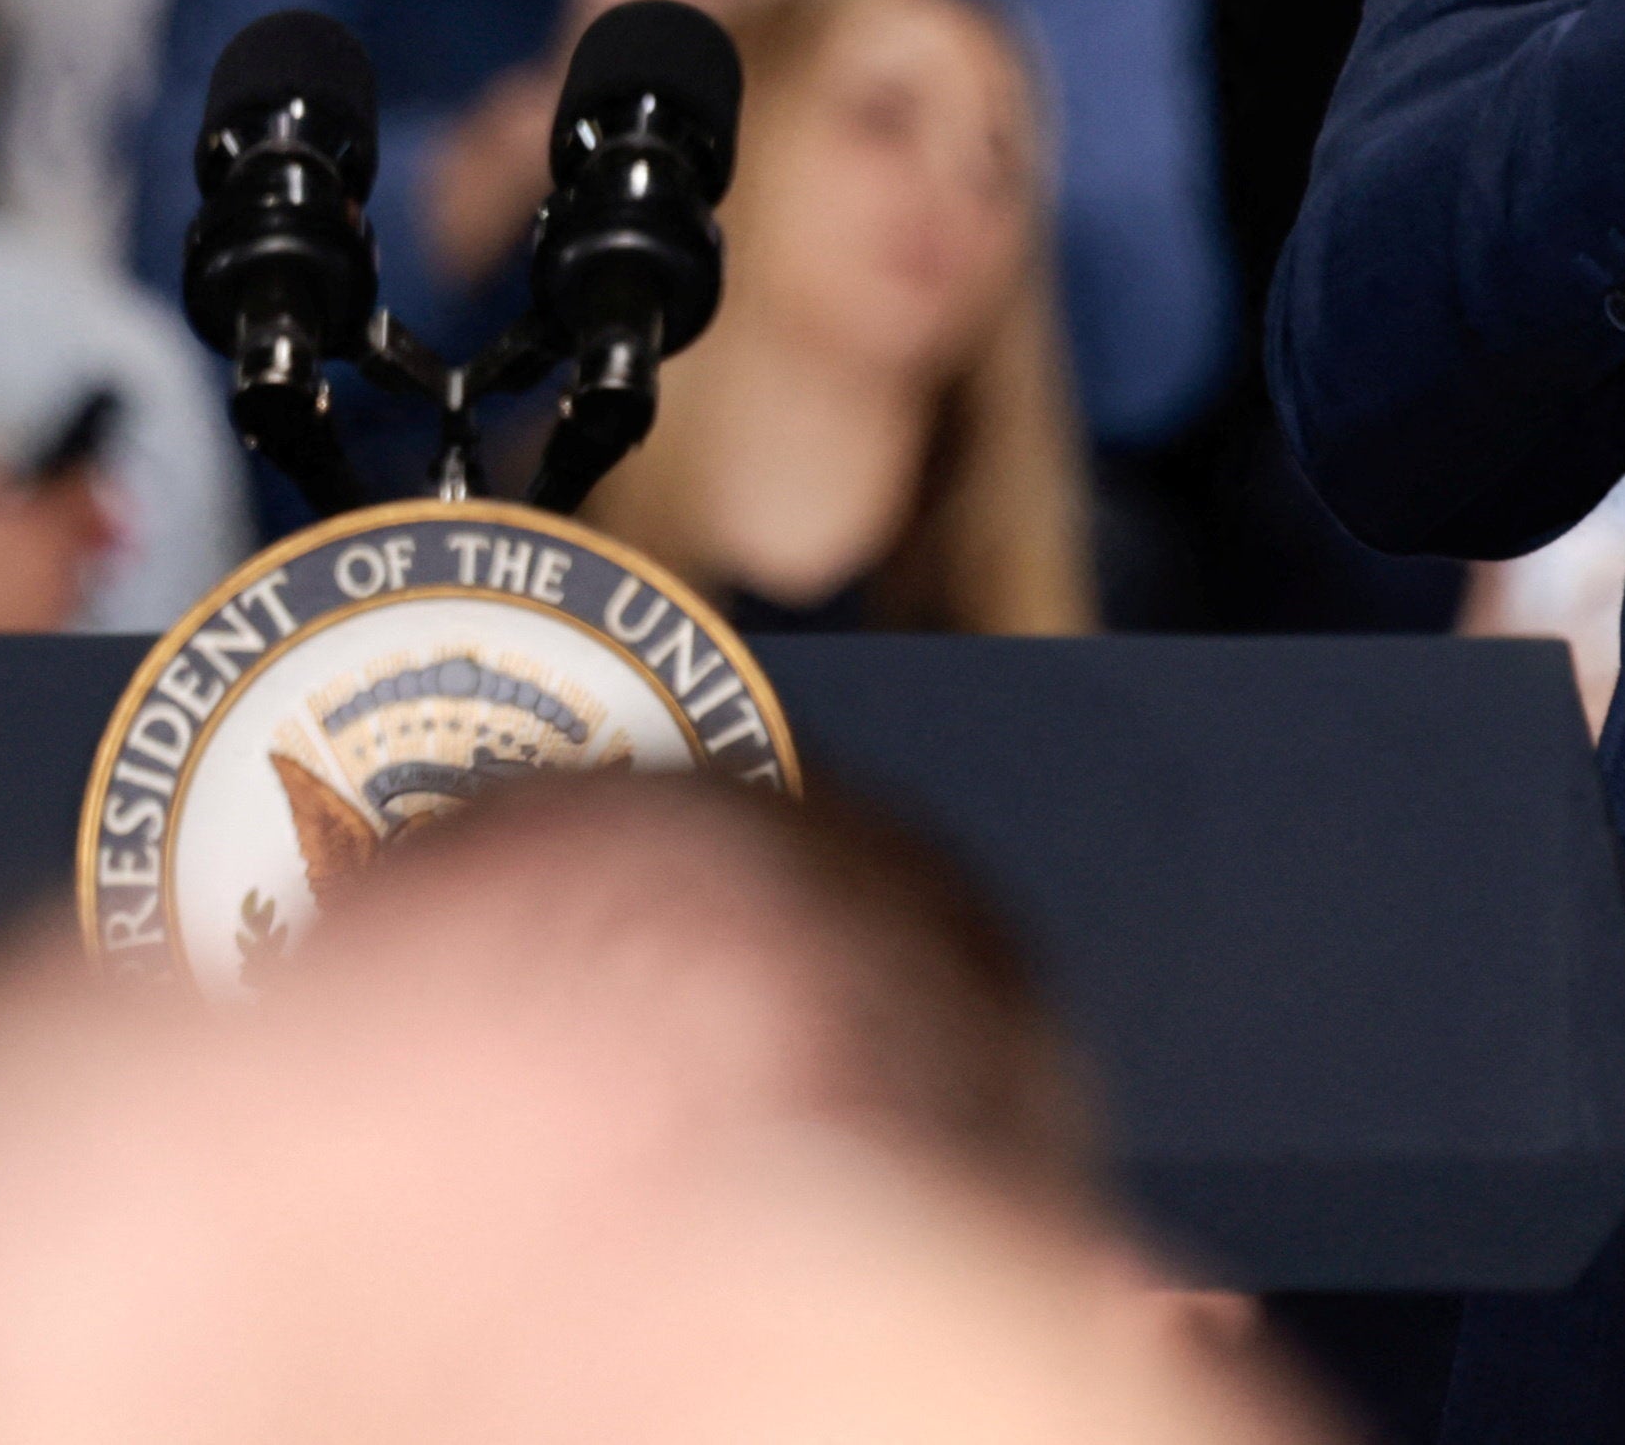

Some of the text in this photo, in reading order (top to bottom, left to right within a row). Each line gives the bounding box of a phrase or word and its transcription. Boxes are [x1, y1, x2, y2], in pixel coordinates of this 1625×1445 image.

[99, 531, 782, 955] RESIDENT OF THE UNIT
